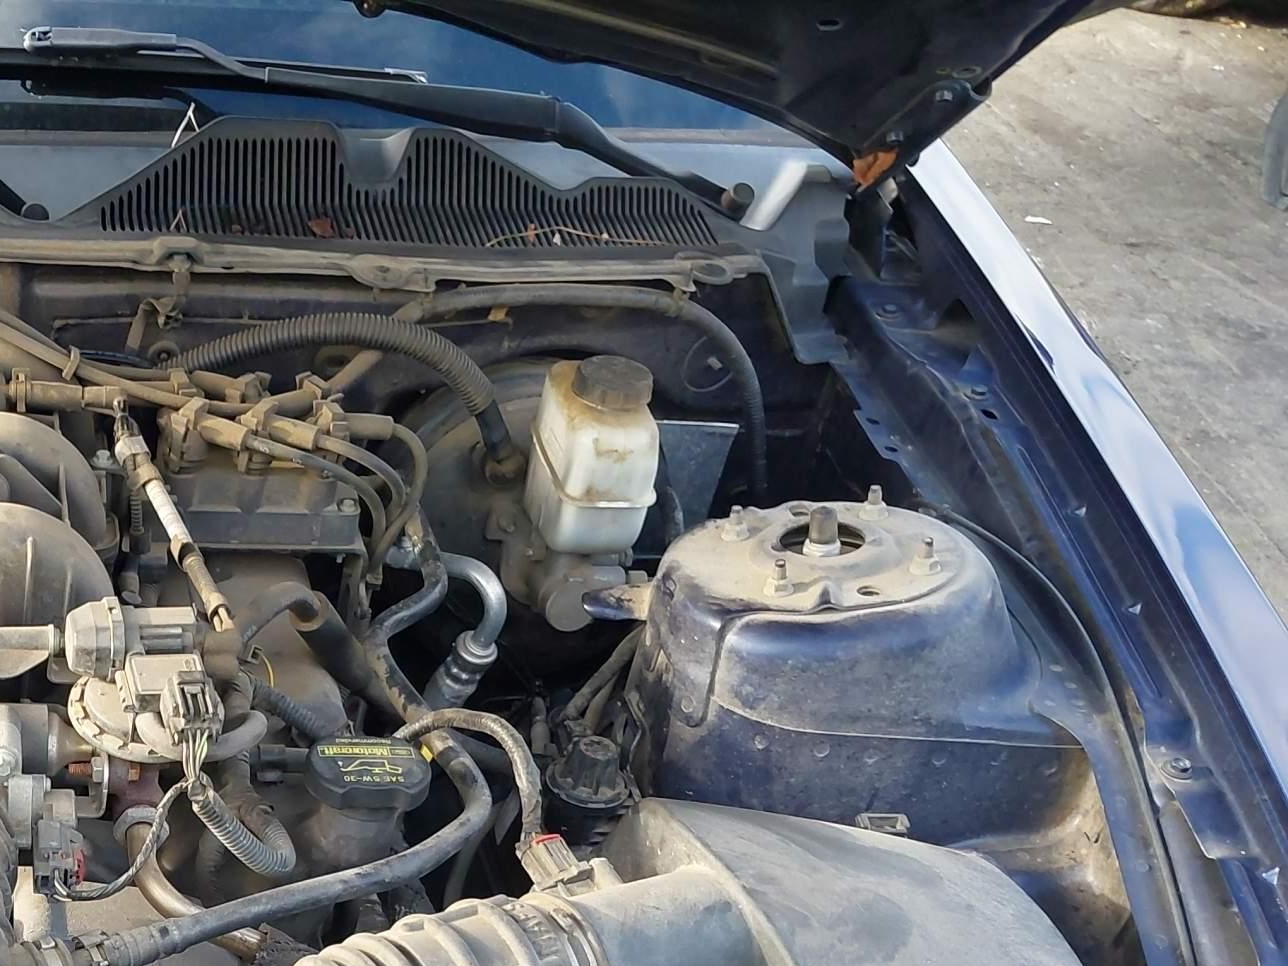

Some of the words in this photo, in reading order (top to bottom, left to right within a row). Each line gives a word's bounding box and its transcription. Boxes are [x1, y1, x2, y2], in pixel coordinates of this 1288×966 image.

[322, 746, 387, 757] Motorcraft
[343, 774, 381, 783] 5W-30
[383, 775, 405, 783] SAE
